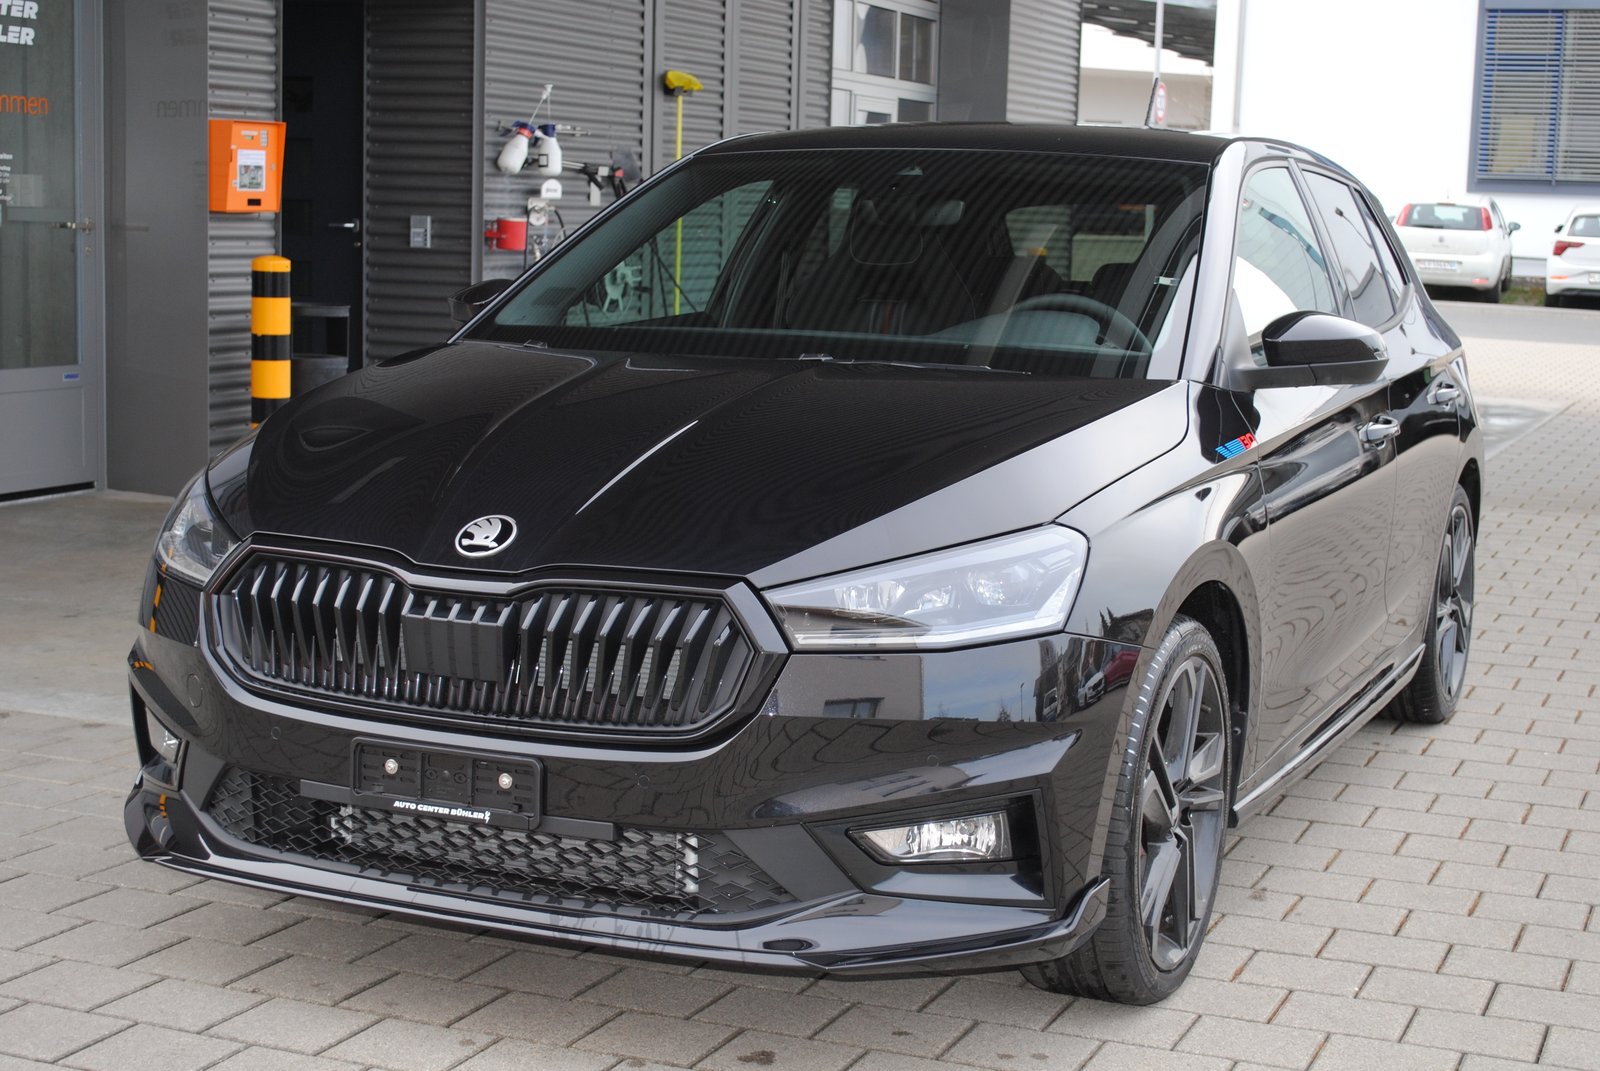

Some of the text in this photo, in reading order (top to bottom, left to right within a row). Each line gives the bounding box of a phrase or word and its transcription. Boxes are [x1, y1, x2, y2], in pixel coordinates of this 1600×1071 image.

[0, 0, 38, 19] TER
[393, 800, 485, 819] AUTO CENTER BÜHLER
